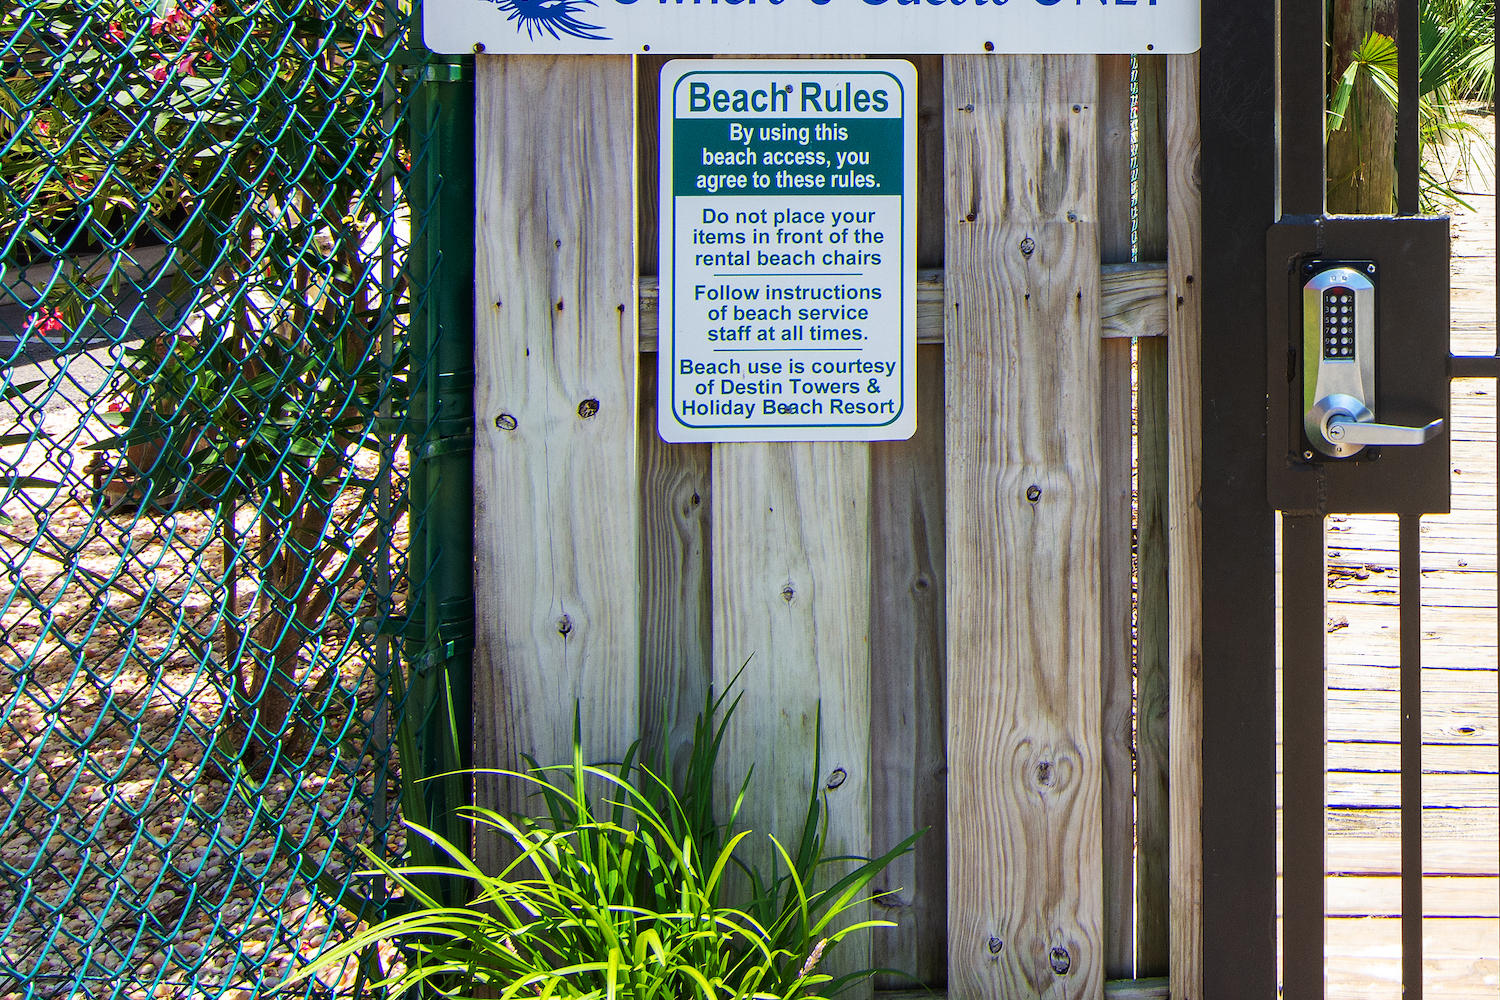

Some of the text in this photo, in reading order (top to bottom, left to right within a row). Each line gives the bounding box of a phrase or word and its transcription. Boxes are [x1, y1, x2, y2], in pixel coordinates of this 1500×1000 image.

[689, 81, 889, 112] Beach Rules
[730, 123, 848, 145] By using this
[702, 148, 869, 169] beach access, you
[696, 170, 880, 192] agree to these rules.
[703, 208, 875, 227] Do not place your
[693, 228, 883, 244] items in front of the
[695, 250, 881, 265] rental beach chairs
[695, 285, 881, 300] Follow instructions
[708, 305, 868, 320] of beach service
[707, 325, 867, 341] staff at all times.
[680, 359, 896, 377] Beach use is courtesy
[696, 378, 881, 394] of Destin Towers &
[682, 399, 895, 419] Holiday Beach Resort
